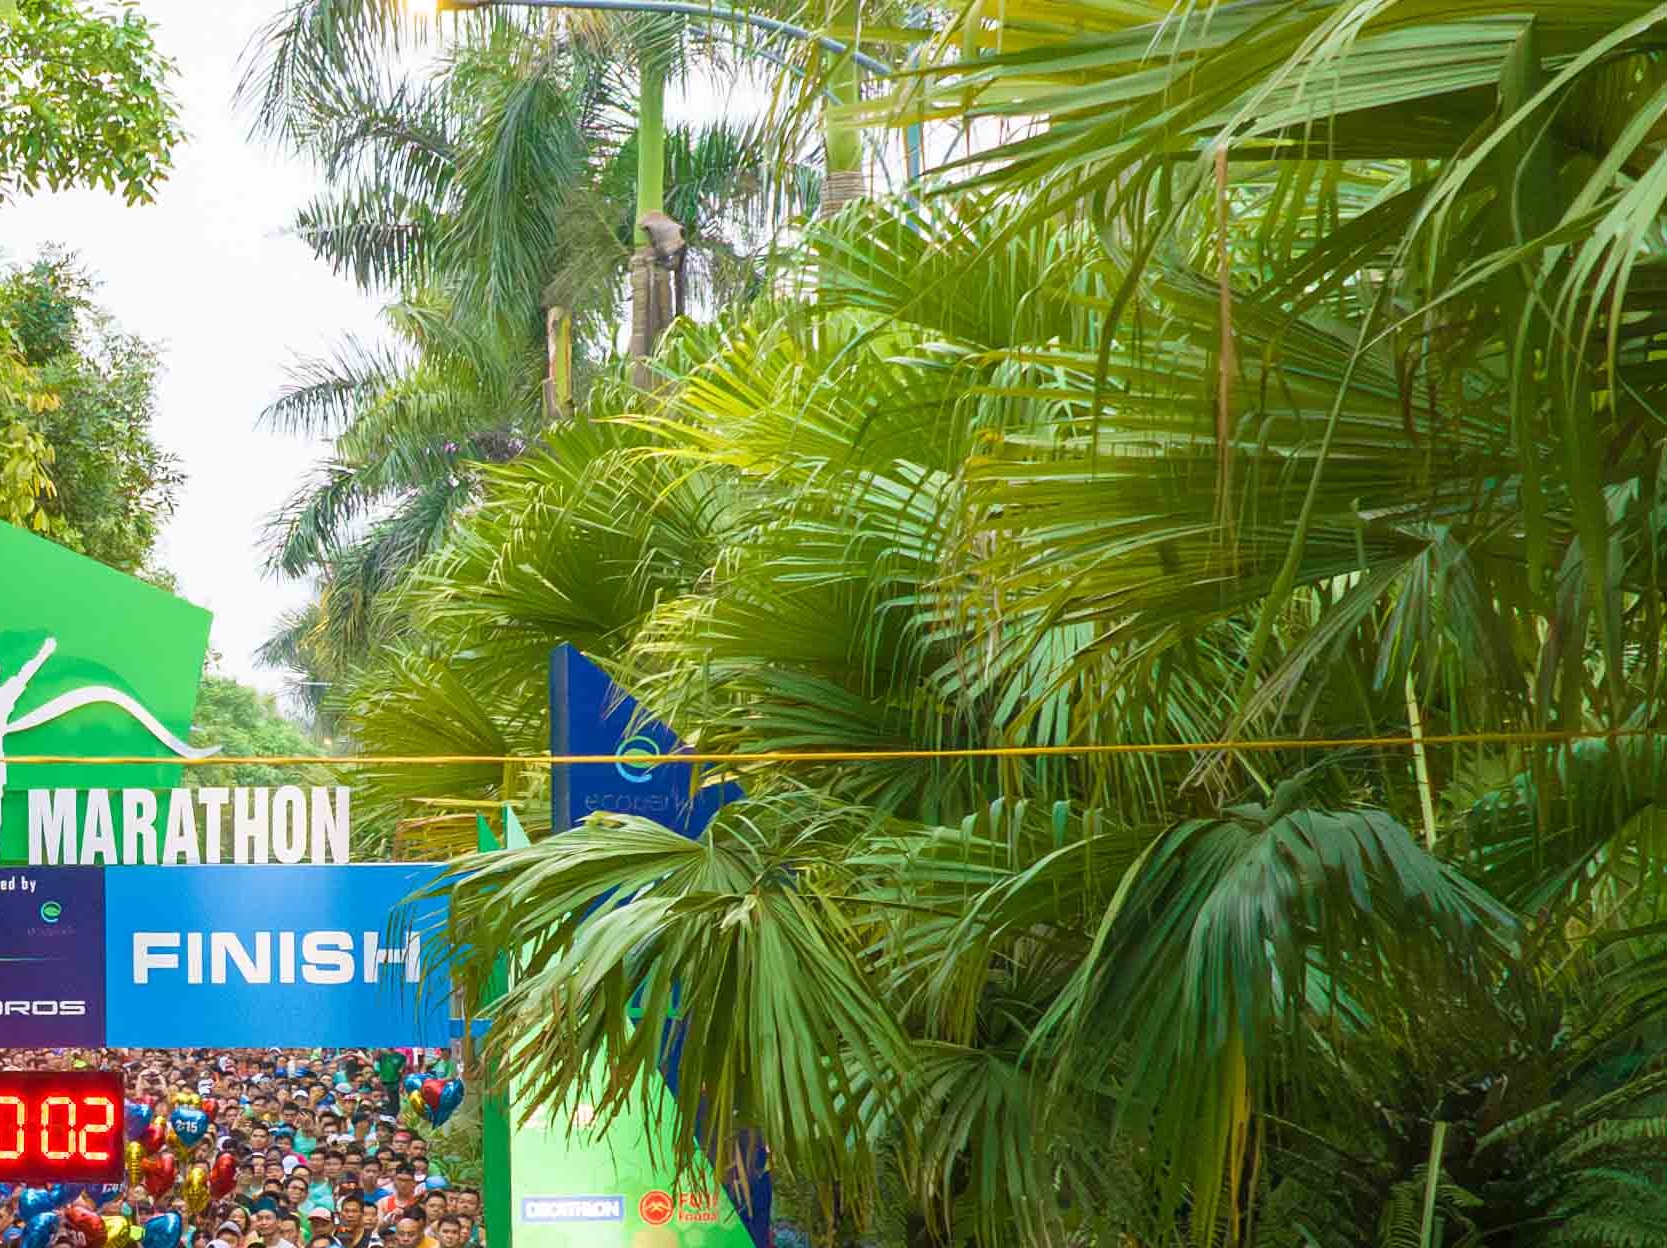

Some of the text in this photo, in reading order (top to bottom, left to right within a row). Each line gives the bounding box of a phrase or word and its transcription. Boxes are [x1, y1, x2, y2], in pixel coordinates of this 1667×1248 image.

[28, 785, 350, 865] MARATHON
[21, 876, 37, 893] by
[133, 931, 421, 983] FINISH
[41, 1096, 115, 1160] 02
